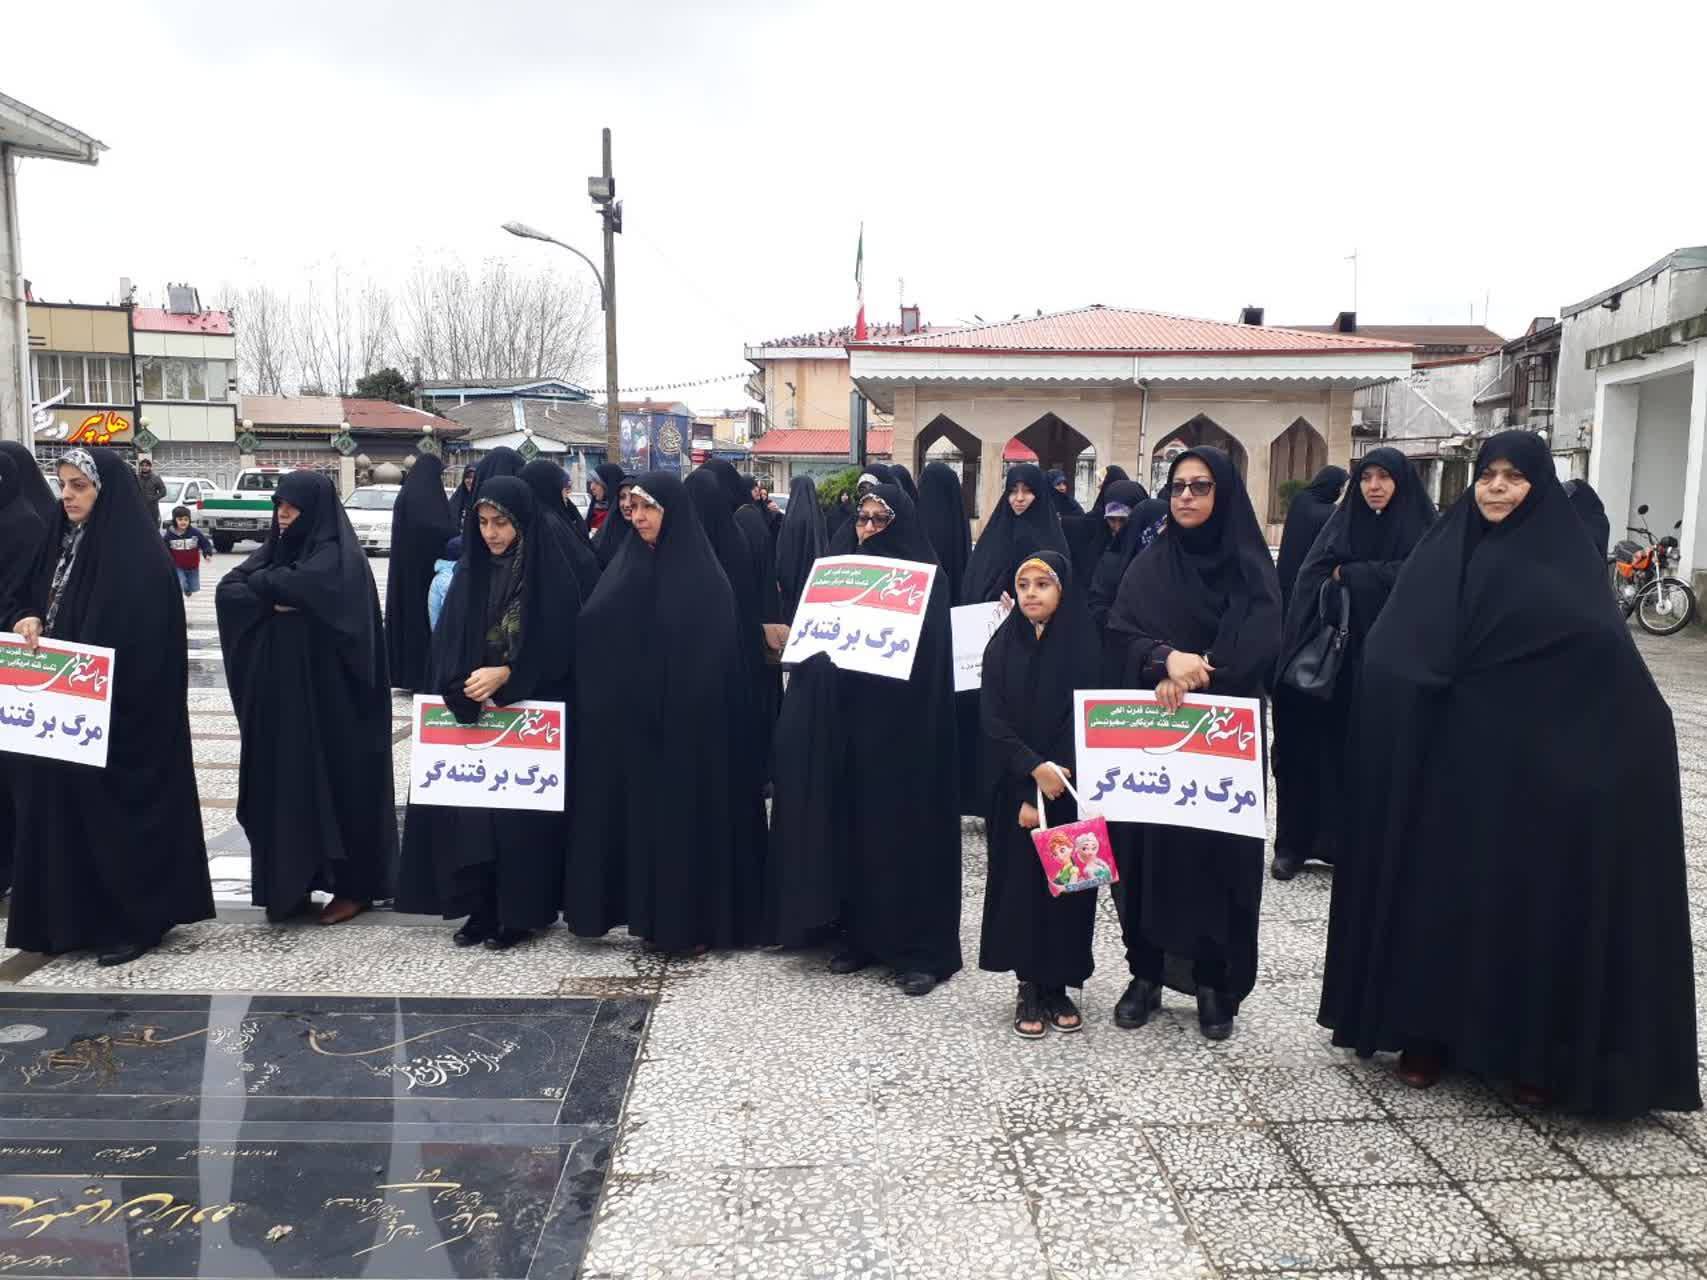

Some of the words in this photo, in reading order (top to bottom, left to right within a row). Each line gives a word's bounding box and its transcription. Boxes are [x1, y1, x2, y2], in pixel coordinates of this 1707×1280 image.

[68, 410, 129, 444] هایپر
[838, 629, 860, 651] بر
[865, 627, 910, 658] مرگ
[34, 716, 56, 739] بر
[61, 713, 103, 746] مرگ
[487, 769, 508, 791] بر
[514, 764, 558, 794] مرگ
[1174, 779, 1198, 806] بر
[1204, 777, 1256, 813] مرگ
